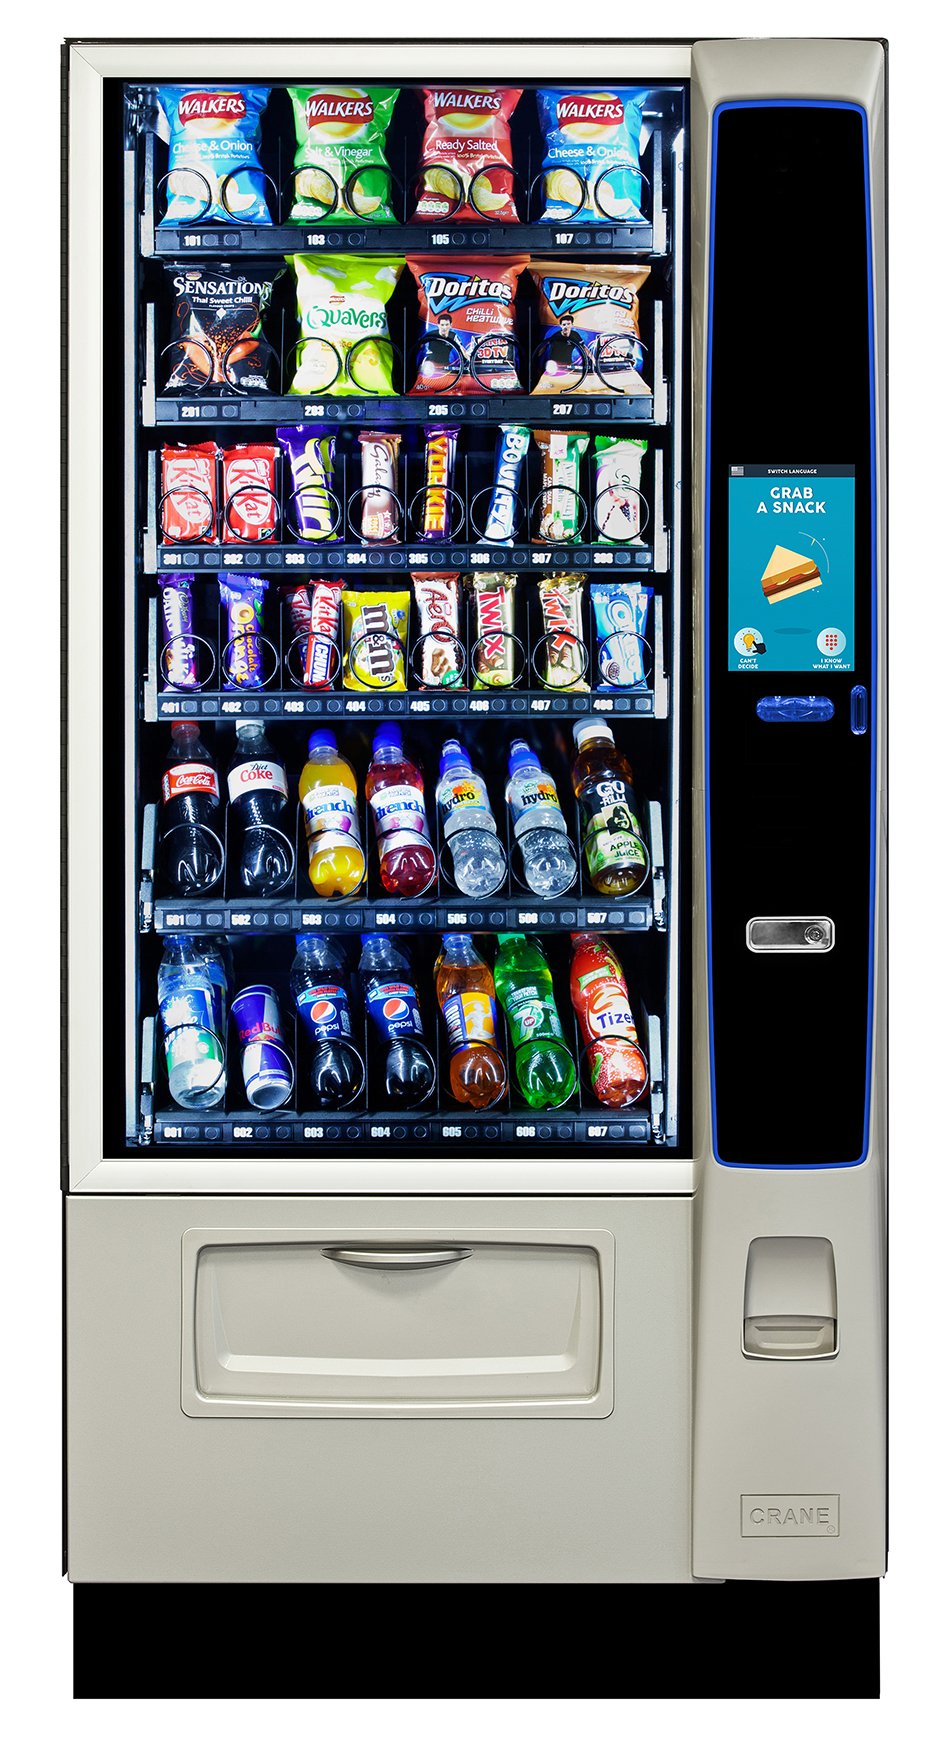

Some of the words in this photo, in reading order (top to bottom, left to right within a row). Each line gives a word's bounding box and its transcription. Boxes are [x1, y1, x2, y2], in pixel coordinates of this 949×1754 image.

[434, 91, 501, 110] WALKERS
[178, 99, 245, 115] WALKERS
[306, 99, 373, 117] WALKERS
[557, 101, 624, 119] WALKERS
[209, 140, 219, 151] &
[220, 140, 253, 151] Onion
[436, 139, 466, 152] Ready
[467, 139, 498, 151] Salted
[325, 146, 334, 157] &
[334, 146, 373, 159] Vinegar
[548, 147, 584, 158] Cheese
[586, 146, 596, 156] &
[185, 236, 200, 246] 101
[308, 235, 325, 245] 103
[433, 234, 449, 244] 105
[556, 234, 573, 244] 107
[429, 277, 512, 301] Doritos
[550, 280, 633, 304] Doritos
[191, 296, 208, 304] Thai
[209, 296, 233, 304] Sweet
[182, 407, 199, 417] 201
[429, 405, 448, 415] 205
[553, 404, 572, 414] 207
[425, 435, 449, 531] YORKIE
[770, 486, 814, 500] GRAB
[756, 501, 768, 514] A
[772, 501, 827, 514] SNACK
[347, 553, 366, 564] 304
[409, 553, 428, 563] 305
[471, 553, 489, 563] 306
[532, 553, 551, 563] 307
[222, 702, 241, 712] 402
[346, 701, 365, 711] 404
[411, 701, 430, 711] 405
[531, 700, 550, 710] 407
[240, 769, 273, 783] Coke
[597, 781, 625, 798] GO
[520, 790, 557, 806] hydro
[376, 914, 395, 924] 504
[448, 914, 466, 924] 505
[314, 1023, 340, 1036] pepsi
[387, 1020, 413, 1032] pepsi
[239, 1022, 261, 1041] Red
[305, 1128, 323, 1137] 603
[372, 1127, 390, 1137] 604
[443, 1127, 461, 1136] 605
[517, 1127, 535, 1136] 606
[750, 1507, 830, 1525] CRANE
